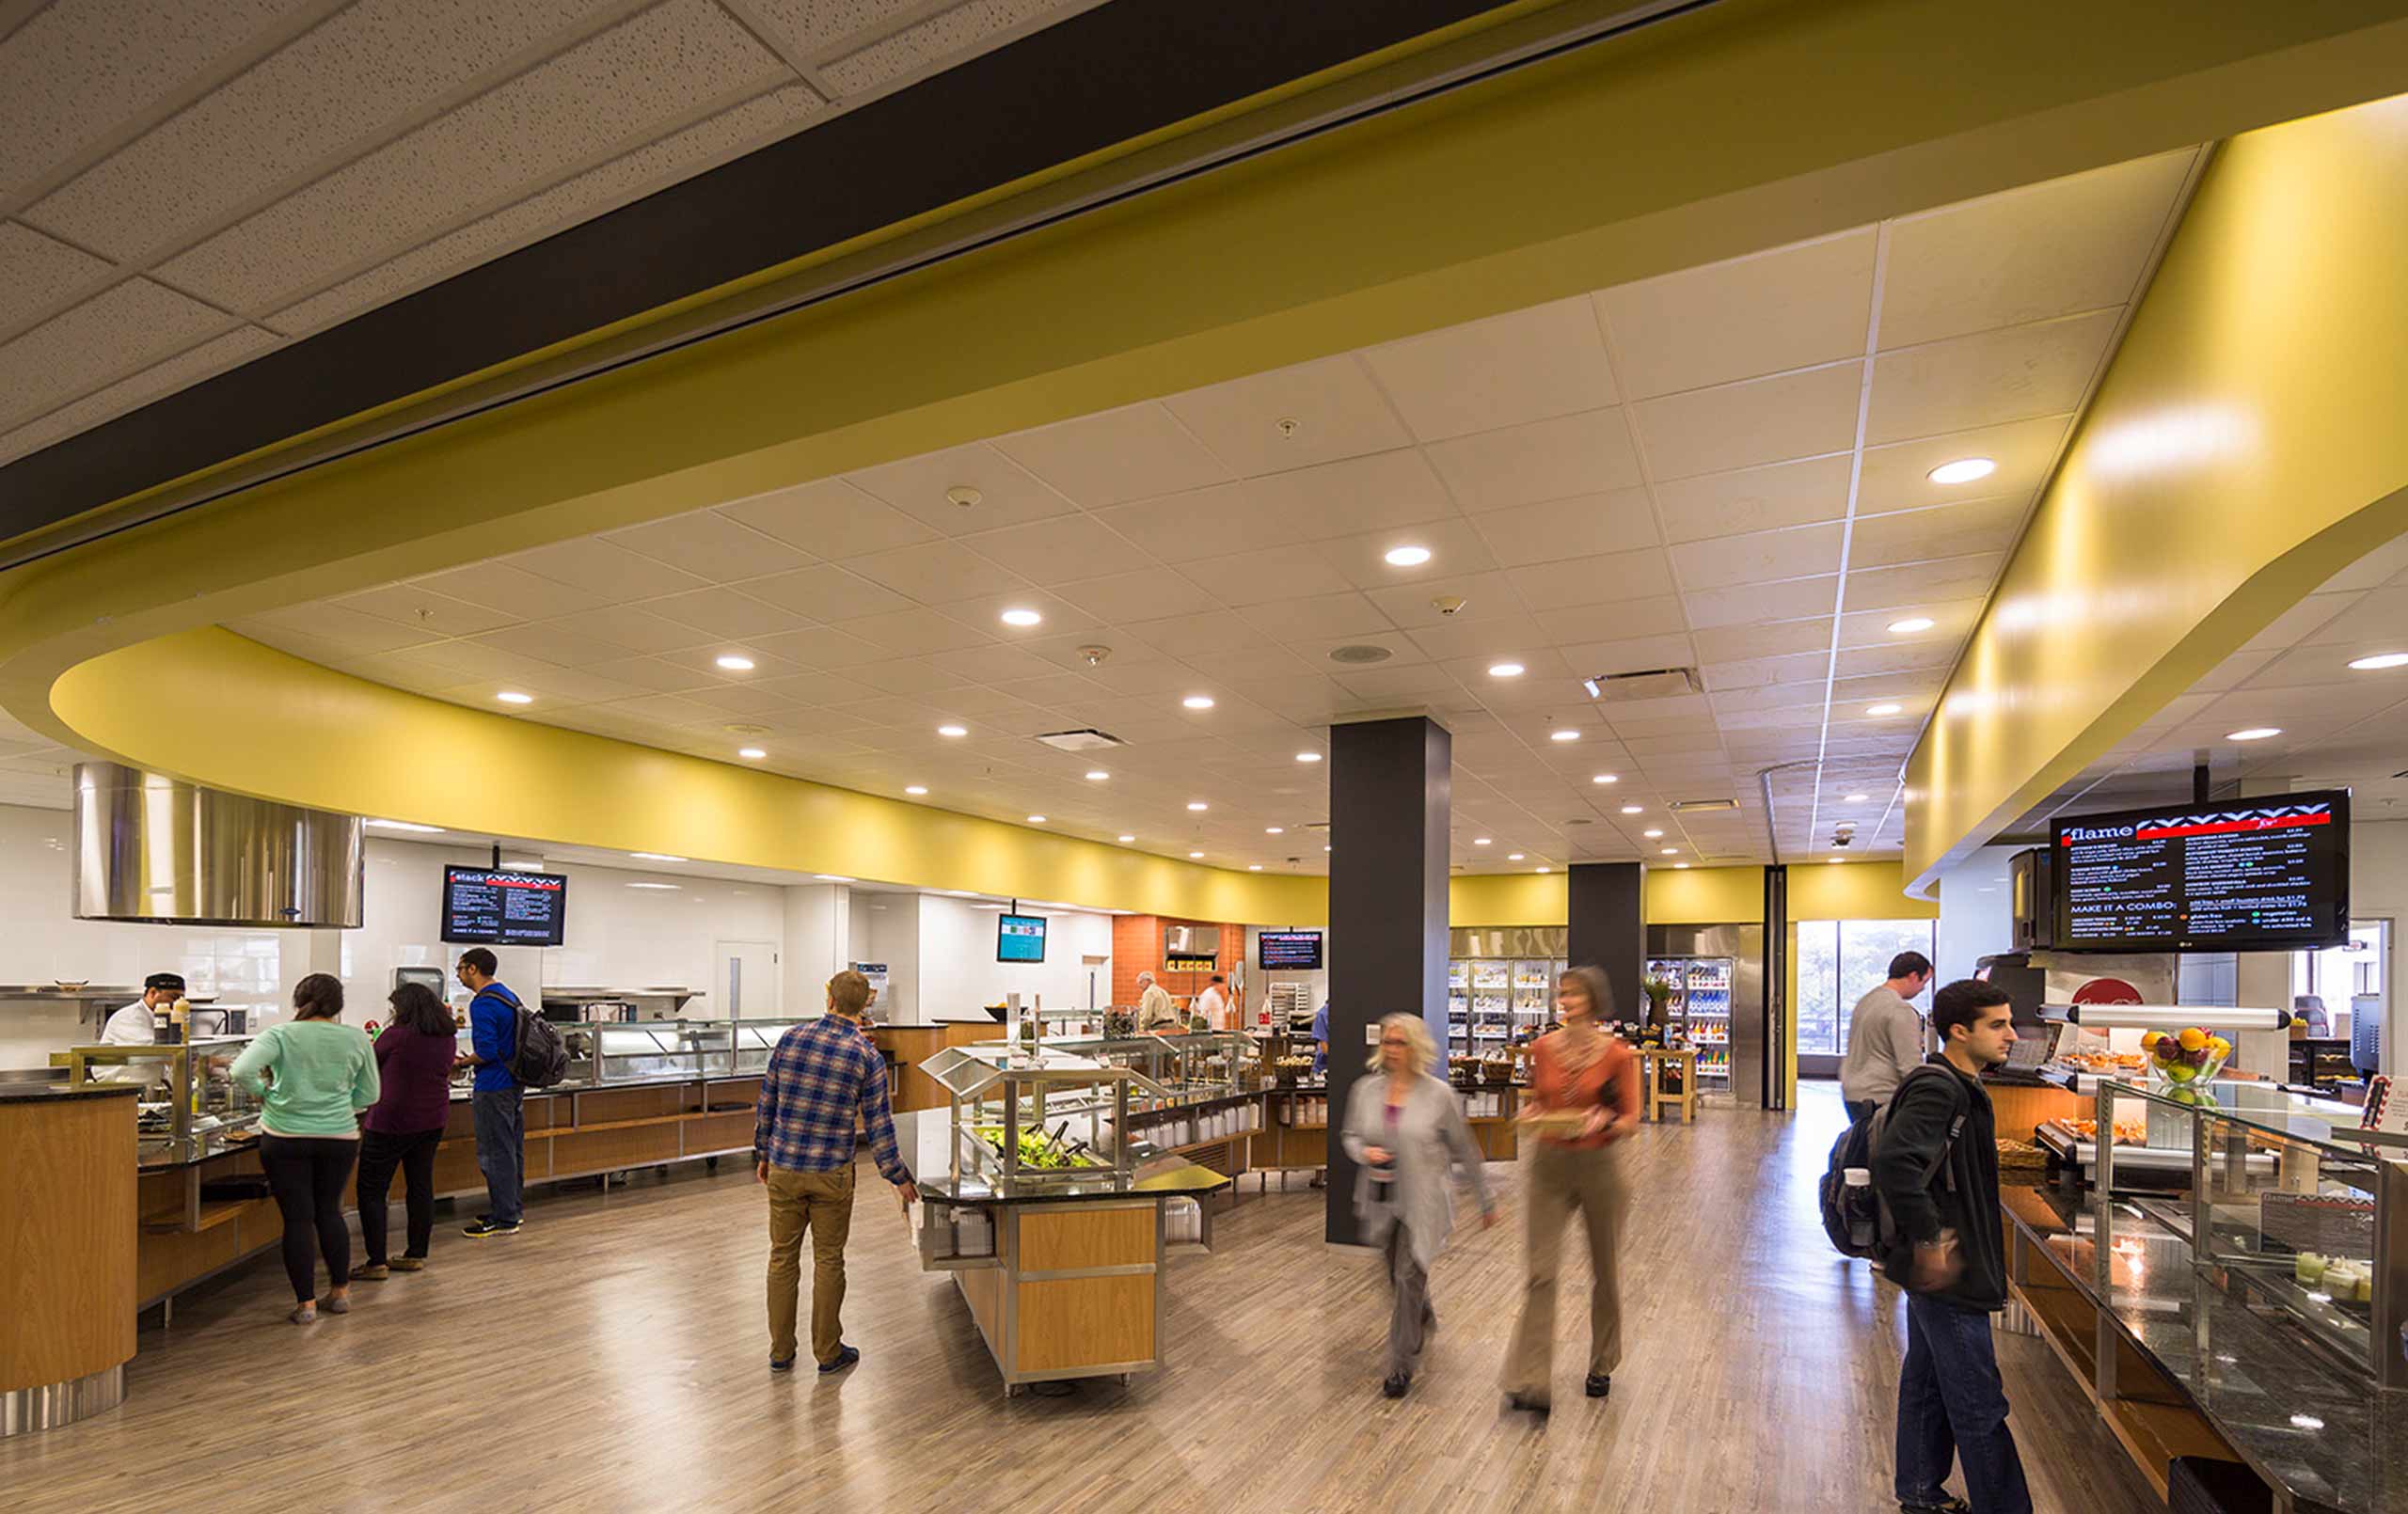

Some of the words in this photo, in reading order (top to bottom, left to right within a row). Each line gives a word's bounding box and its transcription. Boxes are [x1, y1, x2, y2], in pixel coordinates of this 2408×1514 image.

[2071, 828, 2133, 841] flame
[456, 874, 484, 882] stack
[2071, 905, 2101, 913] MAKE
